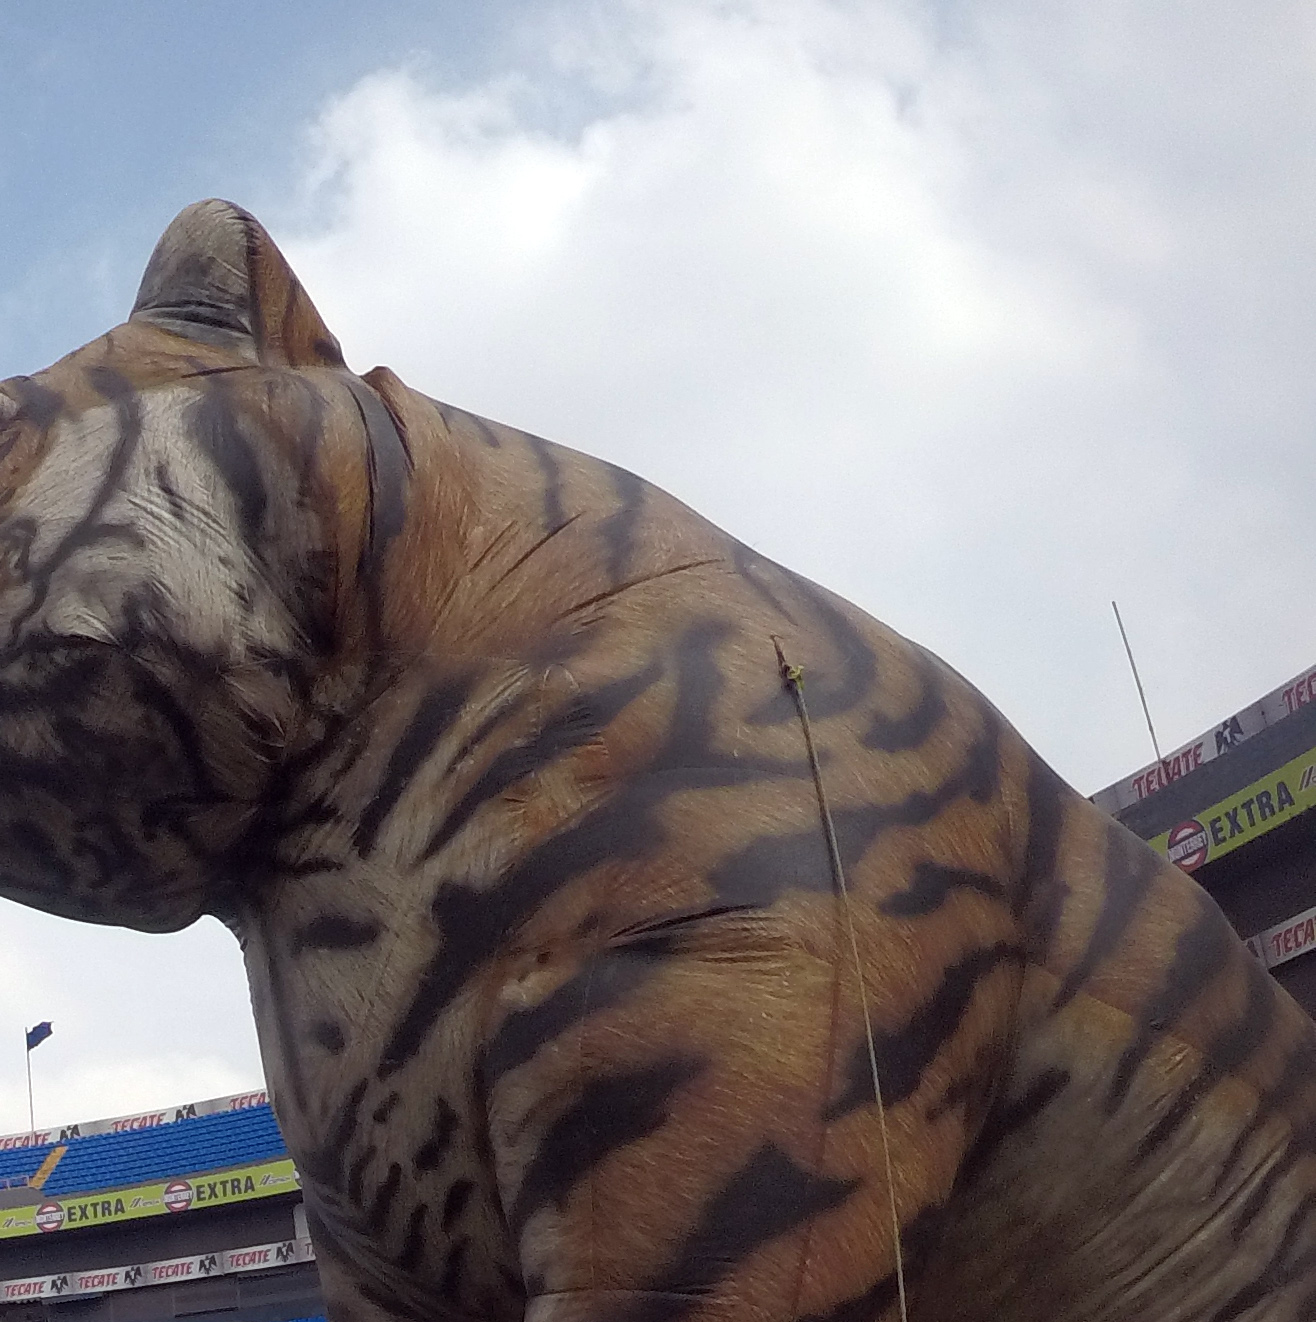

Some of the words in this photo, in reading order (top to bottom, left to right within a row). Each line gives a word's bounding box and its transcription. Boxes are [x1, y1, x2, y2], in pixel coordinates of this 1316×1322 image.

[1209, 781, 1296, 847] EXTRA
[229, 1092, 267, 1110] TECA
[111, 1111, 167, 1132] TECATE
[196, 1175, 256, 1202] EXTRA
[68, 1198, 126, 1223] EXTRA
[229, 1249, 271, 1268] TECATE
[152, 1262, 194, 1279] TECATE
[5, 1281, 46, 1296] TECATE
[78, 1272, 119, 1289] TECATE
